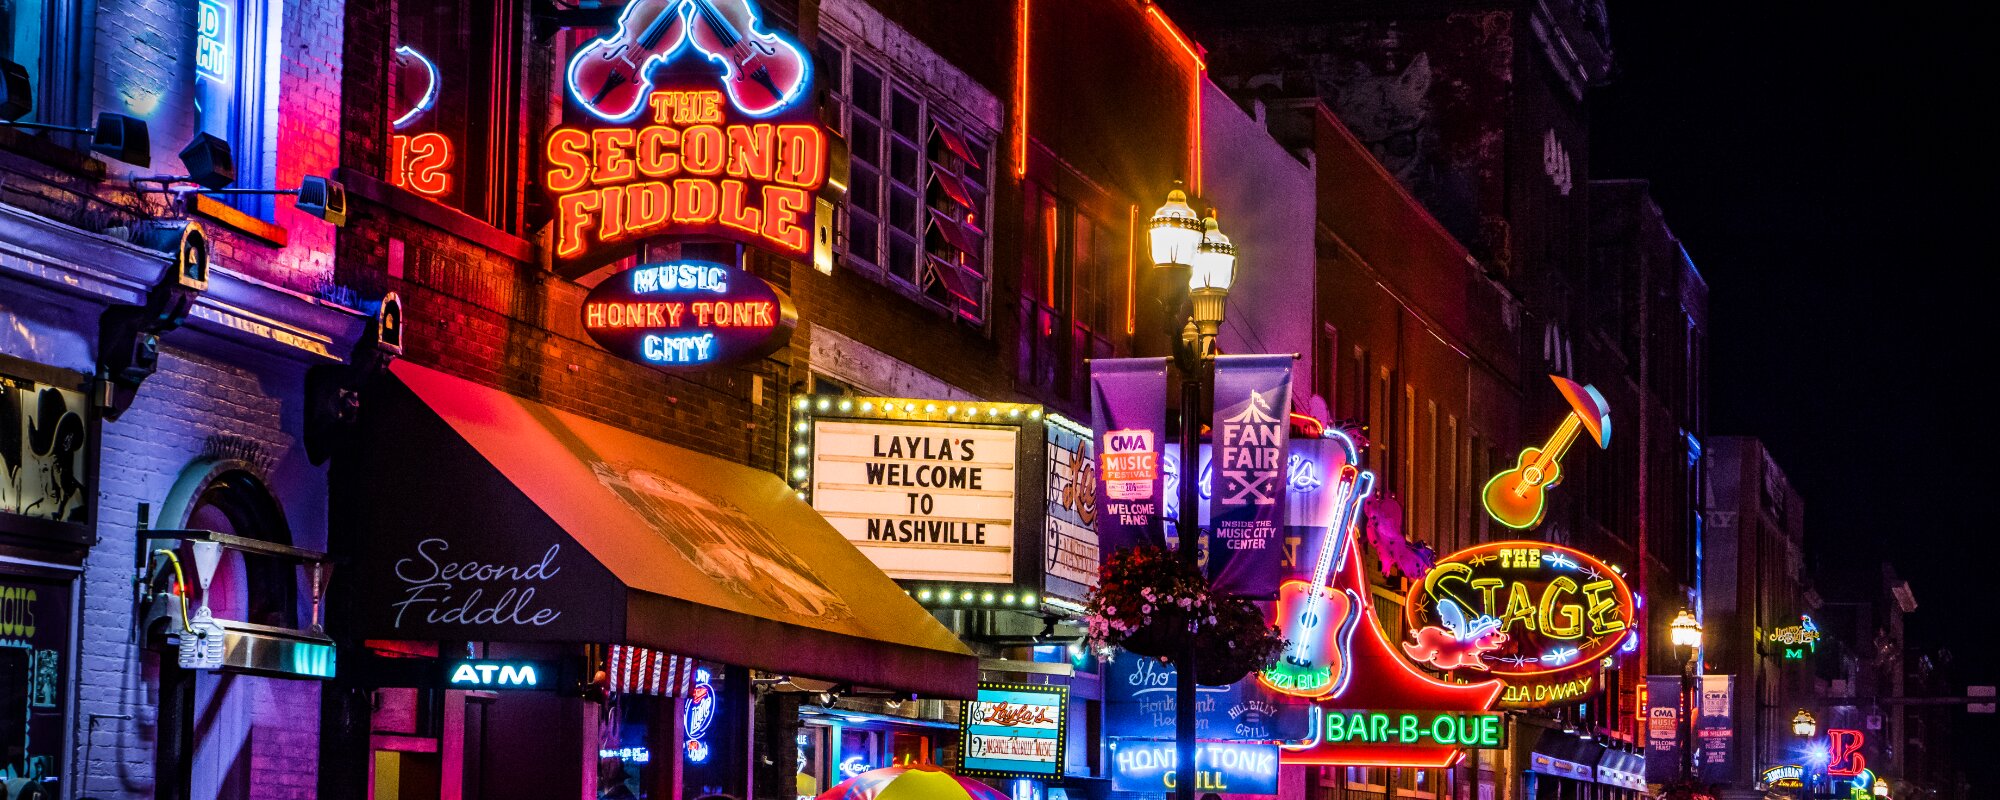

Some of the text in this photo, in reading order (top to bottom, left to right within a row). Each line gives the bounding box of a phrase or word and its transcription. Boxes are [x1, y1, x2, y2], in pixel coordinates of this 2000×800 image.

[650, 90, 724, 123] THE
[547, 123, 828, 192] SECOND
[558, 179, 811, 257] FIDDLE
[633, 262, 728, 293] MUSIC
[587, 301, 775, 327] HONKY TONK
[643, 332, 715, 361] CITY
[1110, 434, 1147, 452] CMA
[1223, 424, 1281, 447] FAN
[873, 434, 975, 461] LAYLA'S
[1222, 447, 1280, 470] FAIR
[1106, 455, 1152, 471] MUSIC
[1107, 470, 1152, 479] FESTIVAL
[866, 462, 982, 490] WELCOME
[1221, 470, 1278, 505] X
[907, 492, 934, 515] TO
[1106, 503, 1155, 515] WELCOME
[867, 518, 986, 545] NASHVILLE
[1216, 527, 1277, 539] MUSIC CITY
[1221, 520, 1254, 528] INSIDE
[1226, 538, 1266, 550] CENTER
[395, 538, 561, 584] Second
[1500, 549, 1541, 569] THE
[392, 582, 561, 629] Fiddle
[1424, 562, 1626, 640] STAGE
[451, 664, 537, 685] ATM
[1228, 700, 1278, 720] HILL BILLY
[1653, 709, 1673, 718] CMA
[1235, 723, 1270, 738] GRILL
[1326, 712, 1500, 746] BAR-B-QUE
[1207, 747, 1275, 776] TONK
[1163, 770, 1227, 789] GILL
